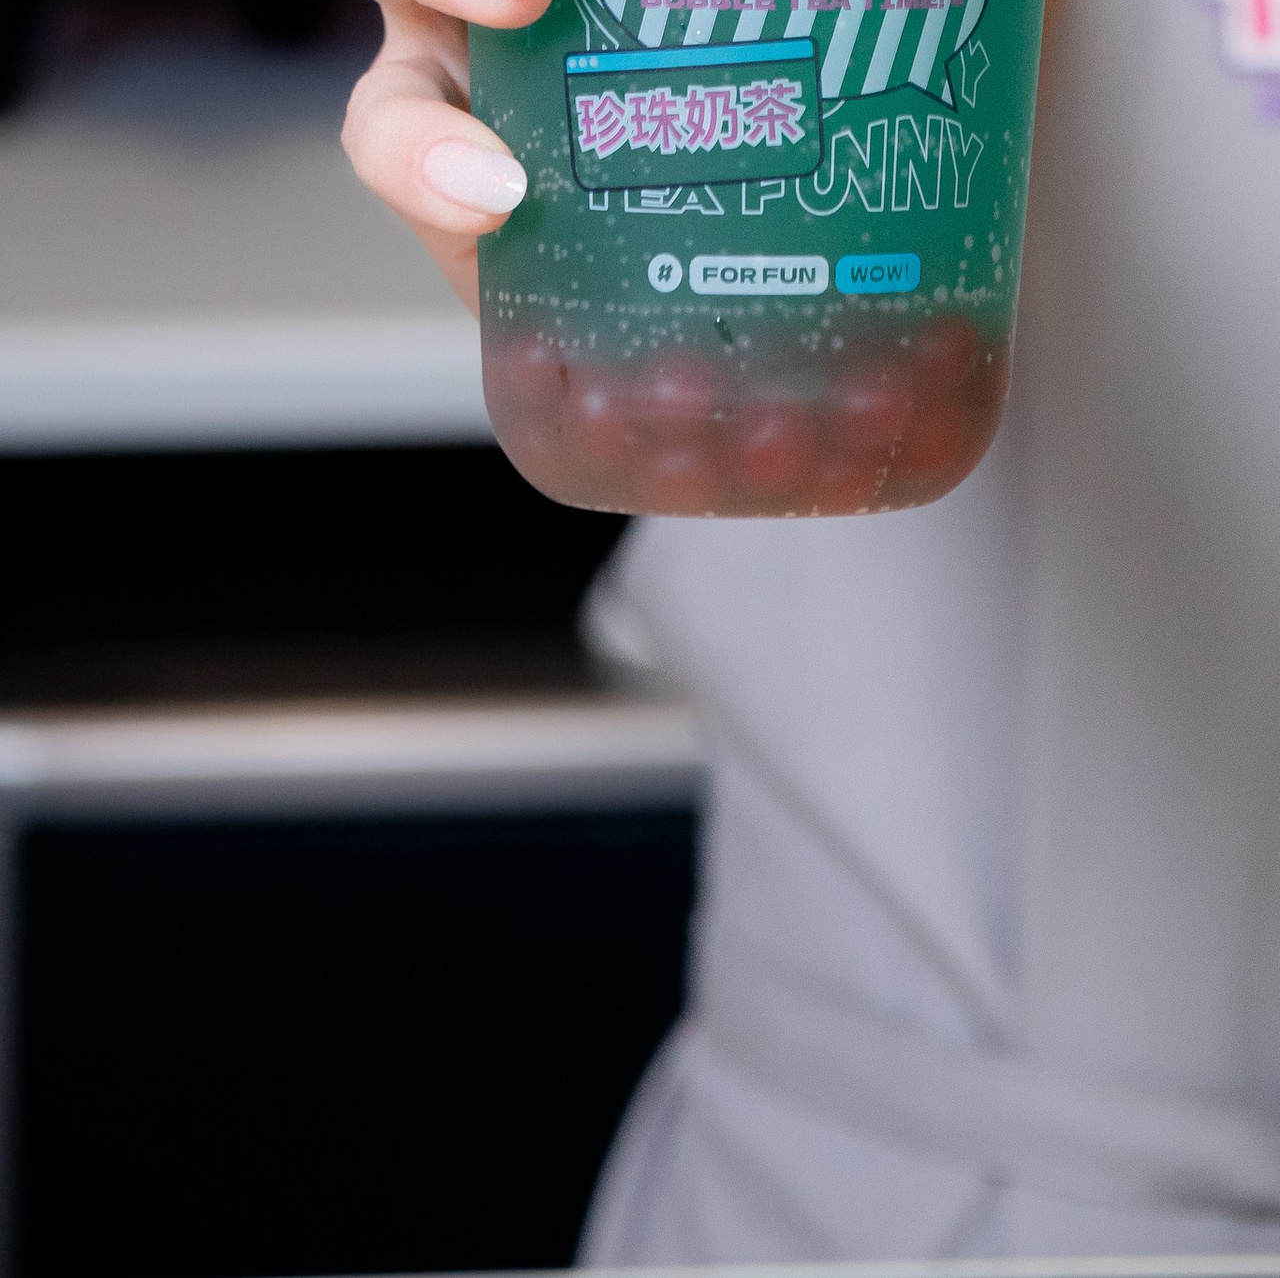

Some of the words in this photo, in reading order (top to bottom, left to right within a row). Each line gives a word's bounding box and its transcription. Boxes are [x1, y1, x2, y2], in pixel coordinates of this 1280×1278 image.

[575, 77, 806, 160] 珍珠奶茶
[702, 266, 757, 285] FOR
[762, 267, 817, 285] FUN
[850, 263, 910, 284] WOW!
